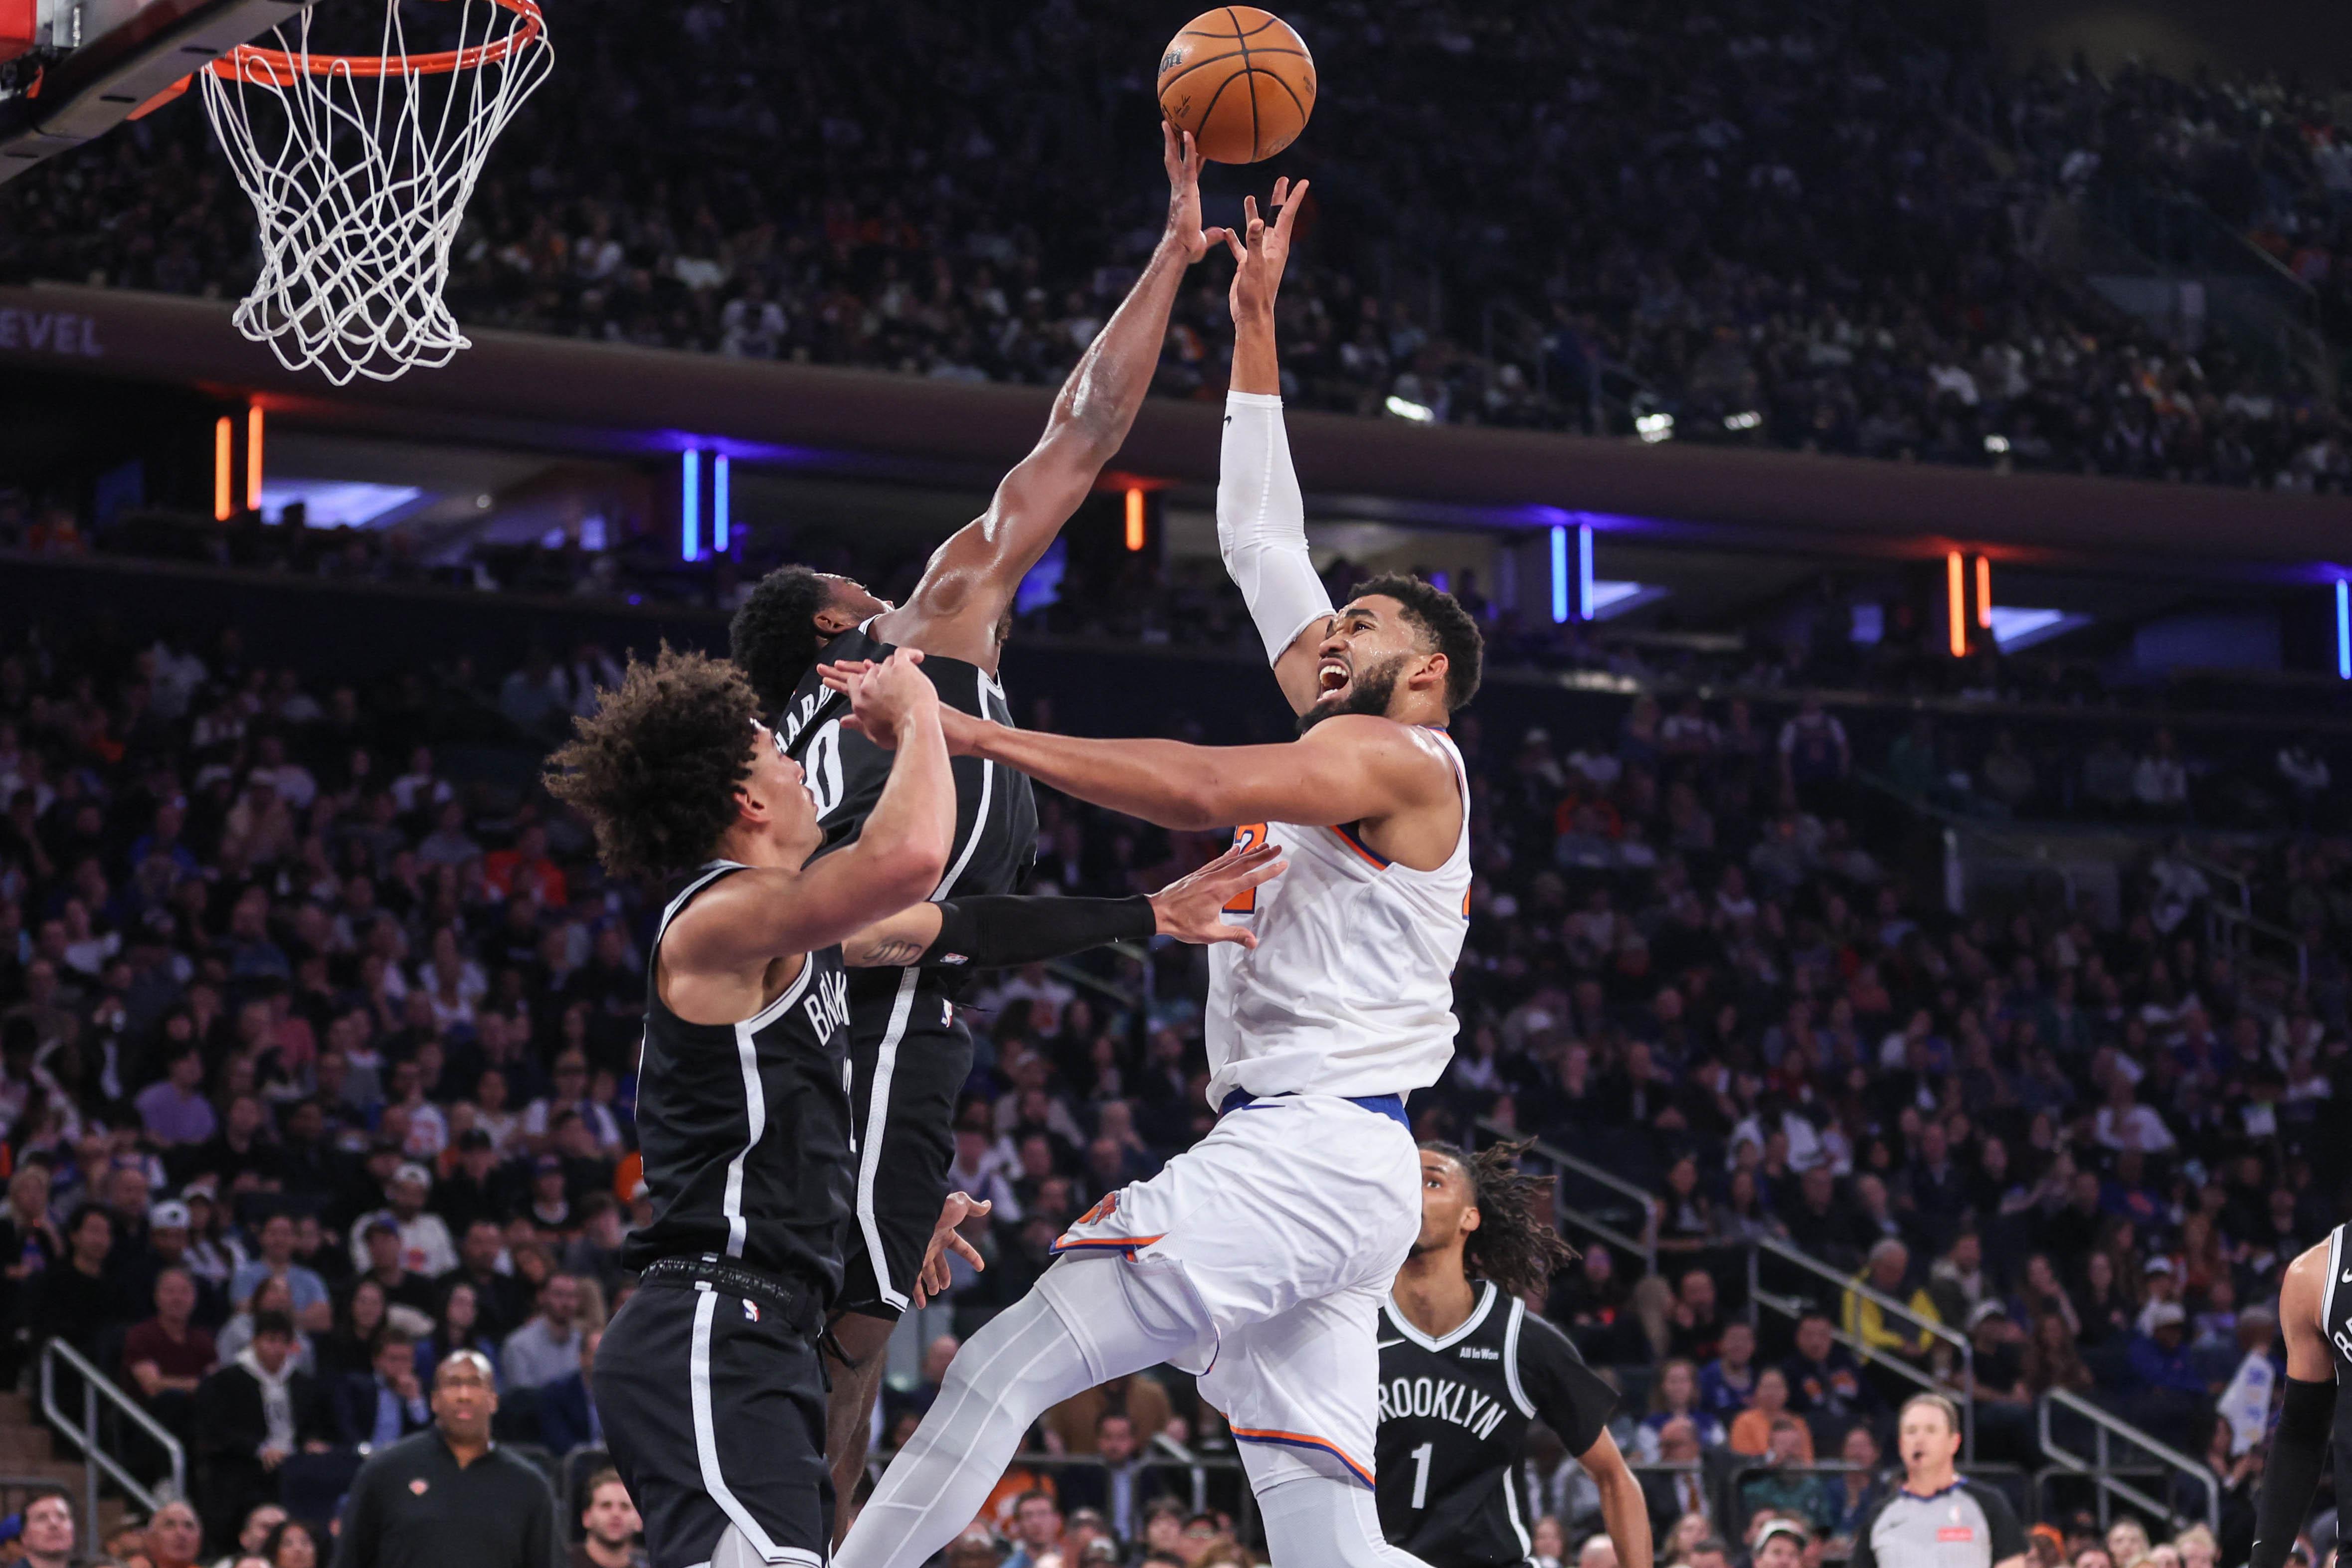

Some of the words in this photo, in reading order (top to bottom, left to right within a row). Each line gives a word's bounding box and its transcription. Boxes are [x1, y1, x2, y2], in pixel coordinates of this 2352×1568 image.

[1460, 1347, 1471, 1358] All
[1472, 1348, 1480, 1359] In
[1481, 1349, 1498, 1360] Won
[1378, 1378, 1507, 1441] ROOKLYN
[1411, 1443, 1433, 1509] 1
